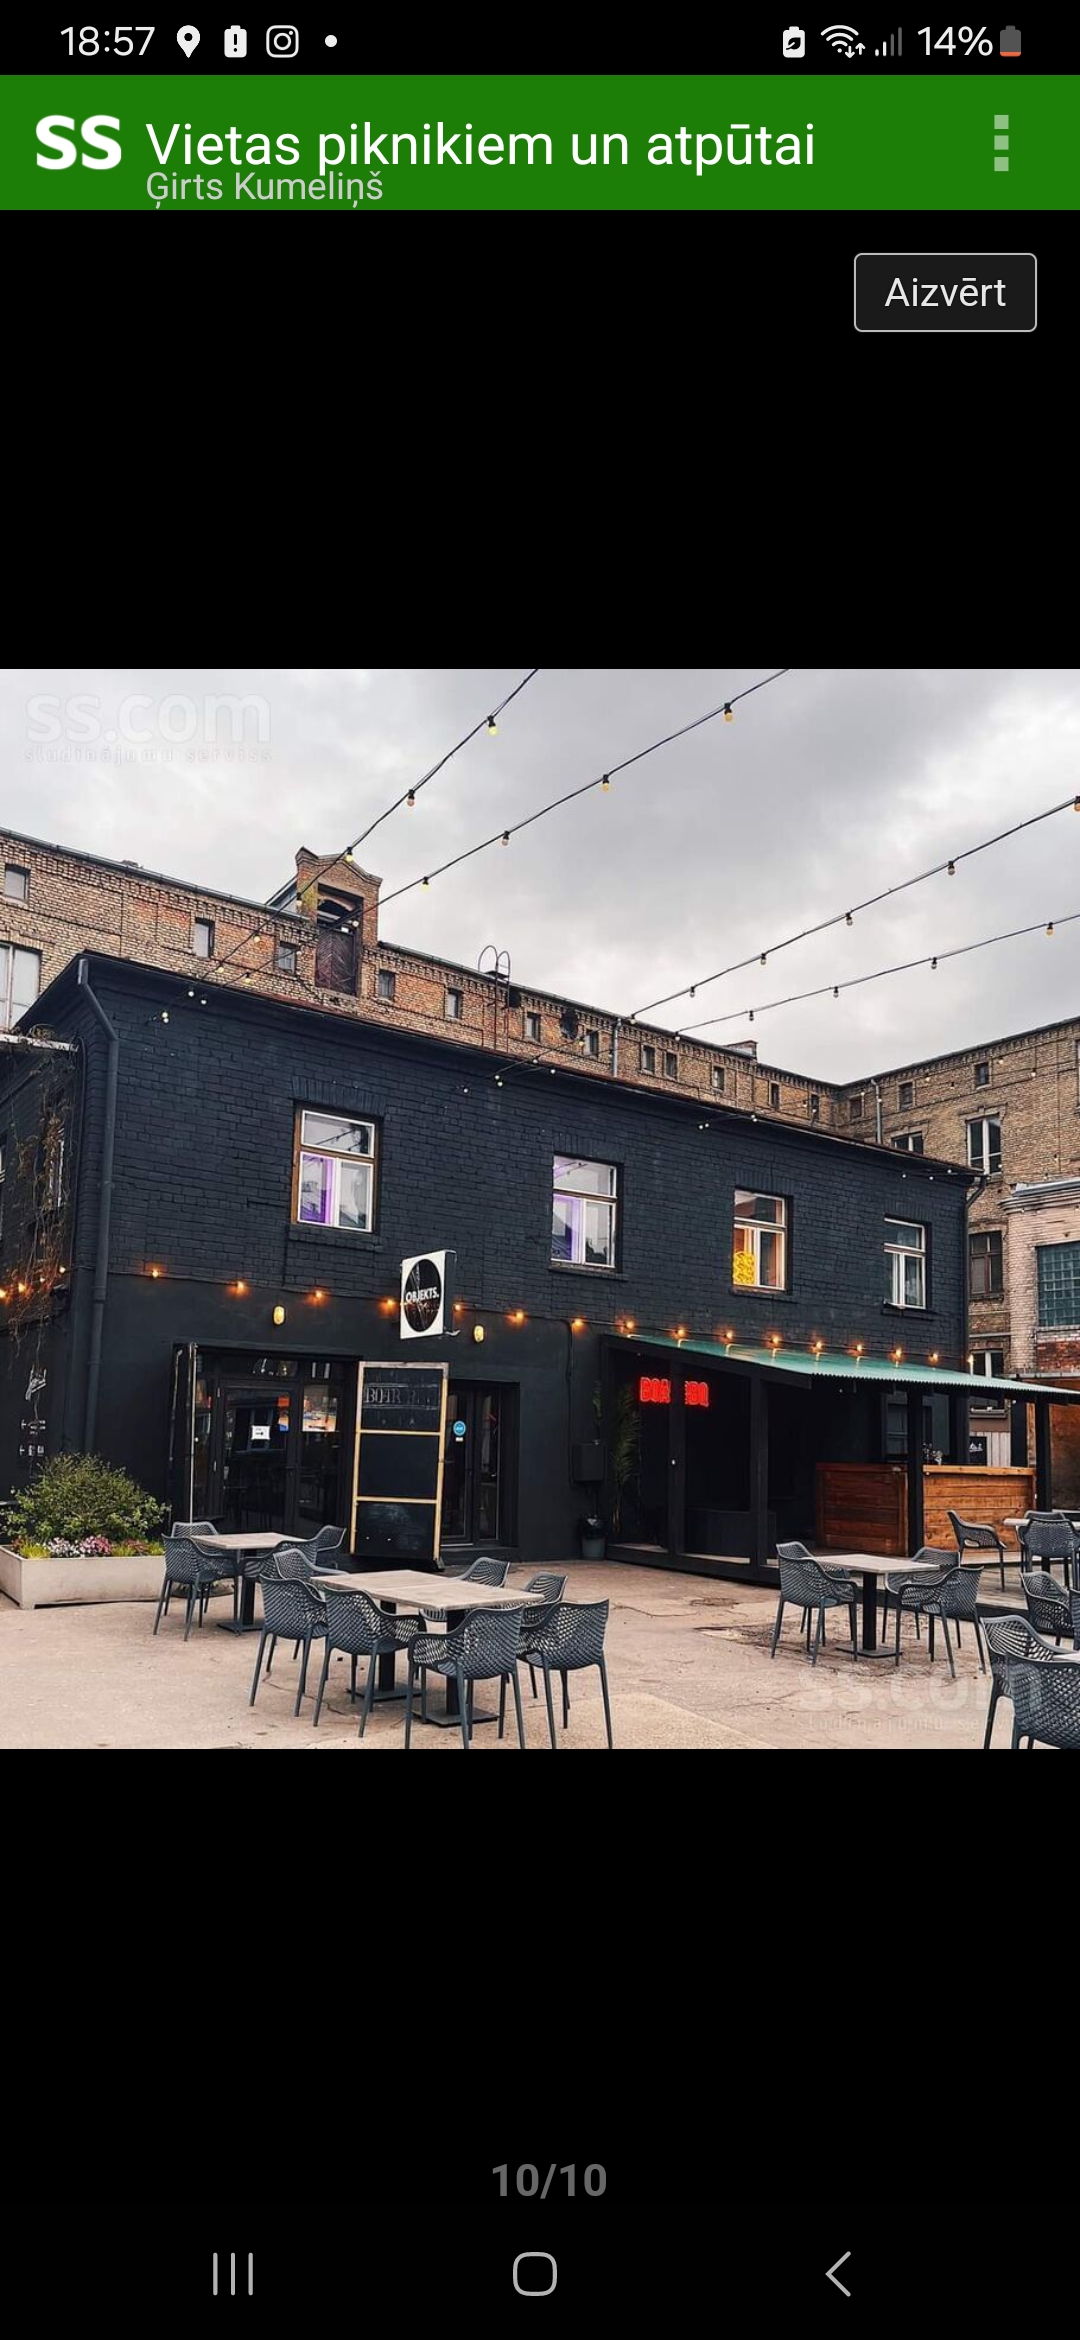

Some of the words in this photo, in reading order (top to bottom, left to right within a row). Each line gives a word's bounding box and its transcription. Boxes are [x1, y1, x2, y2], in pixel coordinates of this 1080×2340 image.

[61, 26, 155, 56] 18:57
[918, 26, 993, 56] 14%
[36, 115, 122, 170] SS
[145, 123, 300, 166] Vietas
[320, 122, 551, 176] piknikiem
[573, 133, 627, 165] un
[648, 123, 814, 176] atpūtai
[146, 171, 223, 209] Ģirts
[235, 171, 383, 209] Kumeliņš
[885, 277, 1007, 306] Aizvērt
[492, 2163, 607, 2199] 10/10
